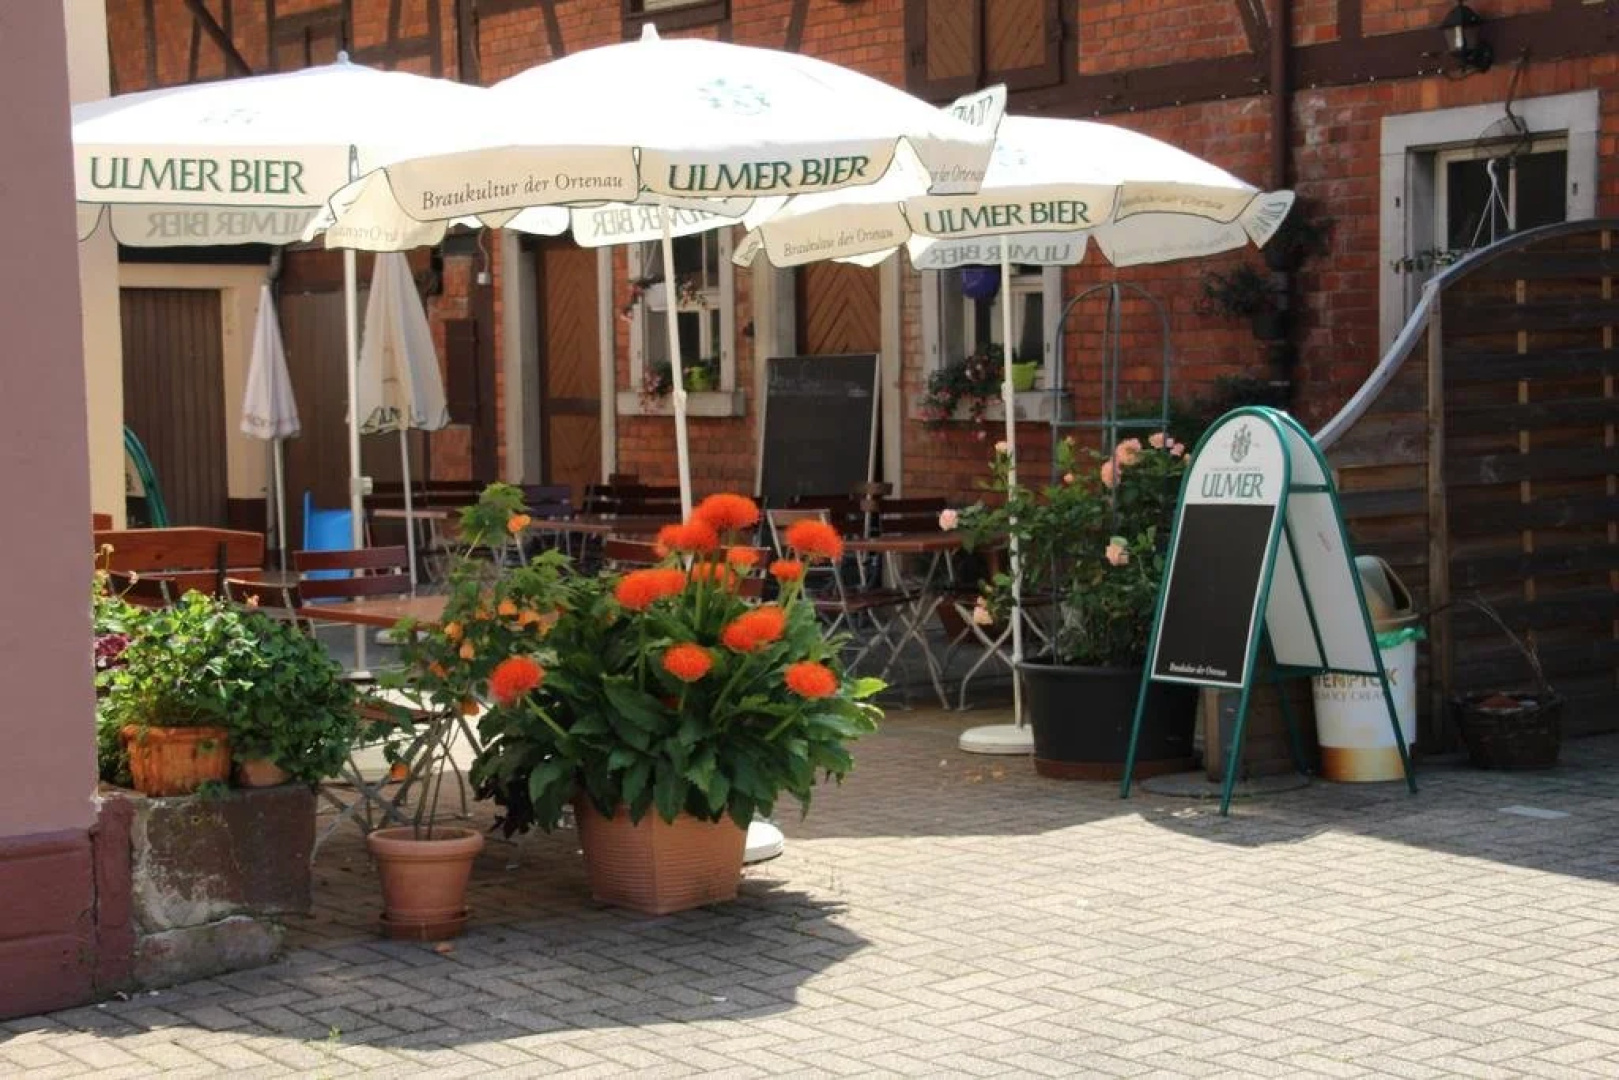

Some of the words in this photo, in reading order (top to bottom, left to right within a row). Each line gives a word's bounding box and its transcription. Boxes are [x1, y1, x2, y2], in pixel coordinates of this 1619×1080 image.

[91, 156, 222, 192] ULMER
[230, 159, 306, 194] BIER
[668, 159, 792, 191] ULMER
[800, 155, 870, 186] BIER
[423, 179, 518, 210] Braukultur
[524, 174, 549, 195] der
[554, 173, 624, 191] Ortenau
[924, 203, 1024, 234] ULMER
[1030, 201, 1089, 224] BIER
[1201, 472, 1265, 499] ULMER
